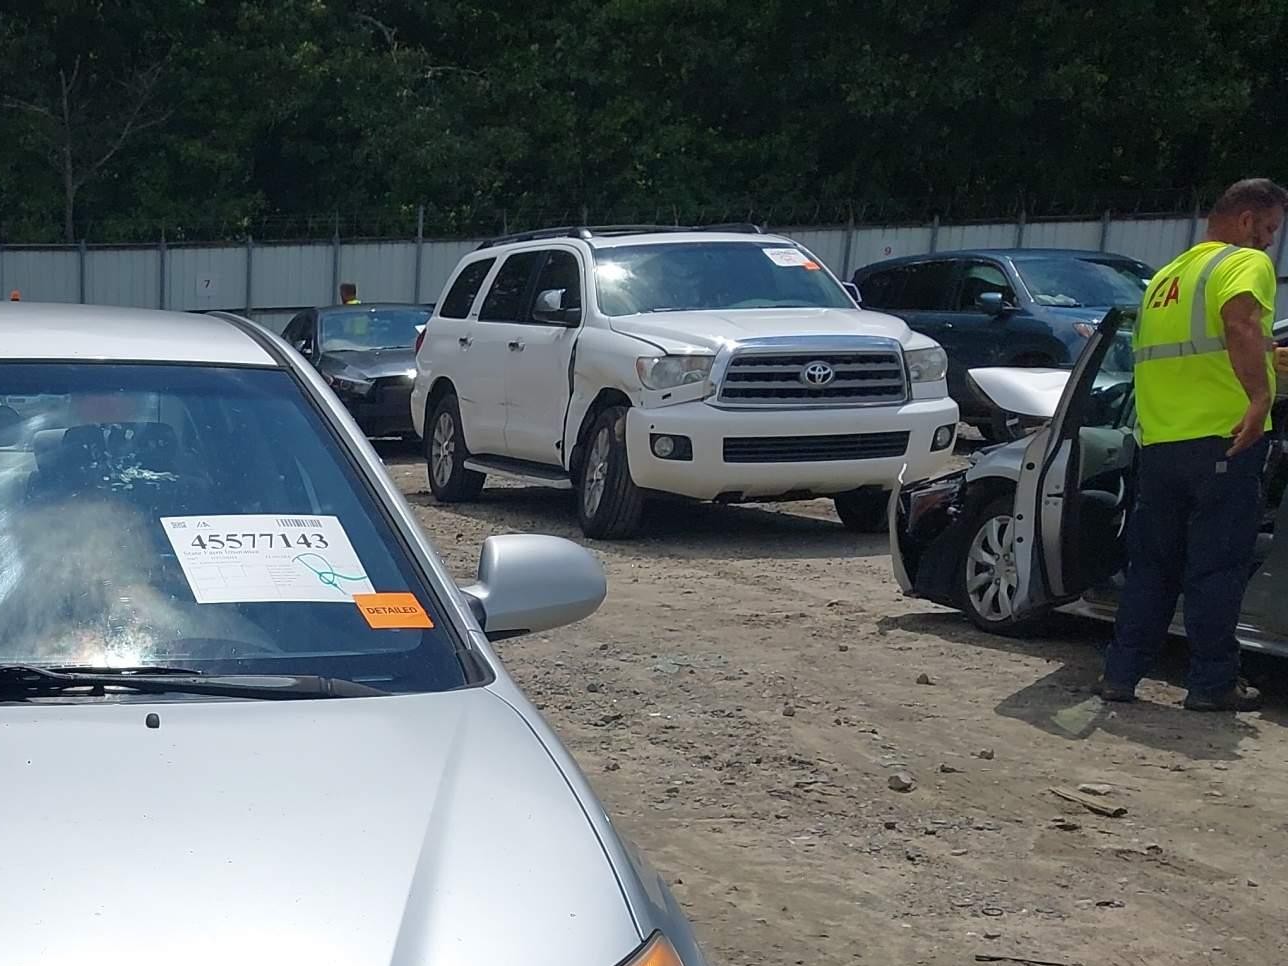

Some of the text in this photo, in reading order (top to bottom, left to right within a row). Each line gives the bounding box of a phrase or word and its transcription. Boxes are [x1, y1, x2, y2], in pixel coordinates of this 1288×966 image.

[884, 246, 892, 256] 9
[204, 279, 211, 289] 7
[191, 533, 329, 550] 45577143
